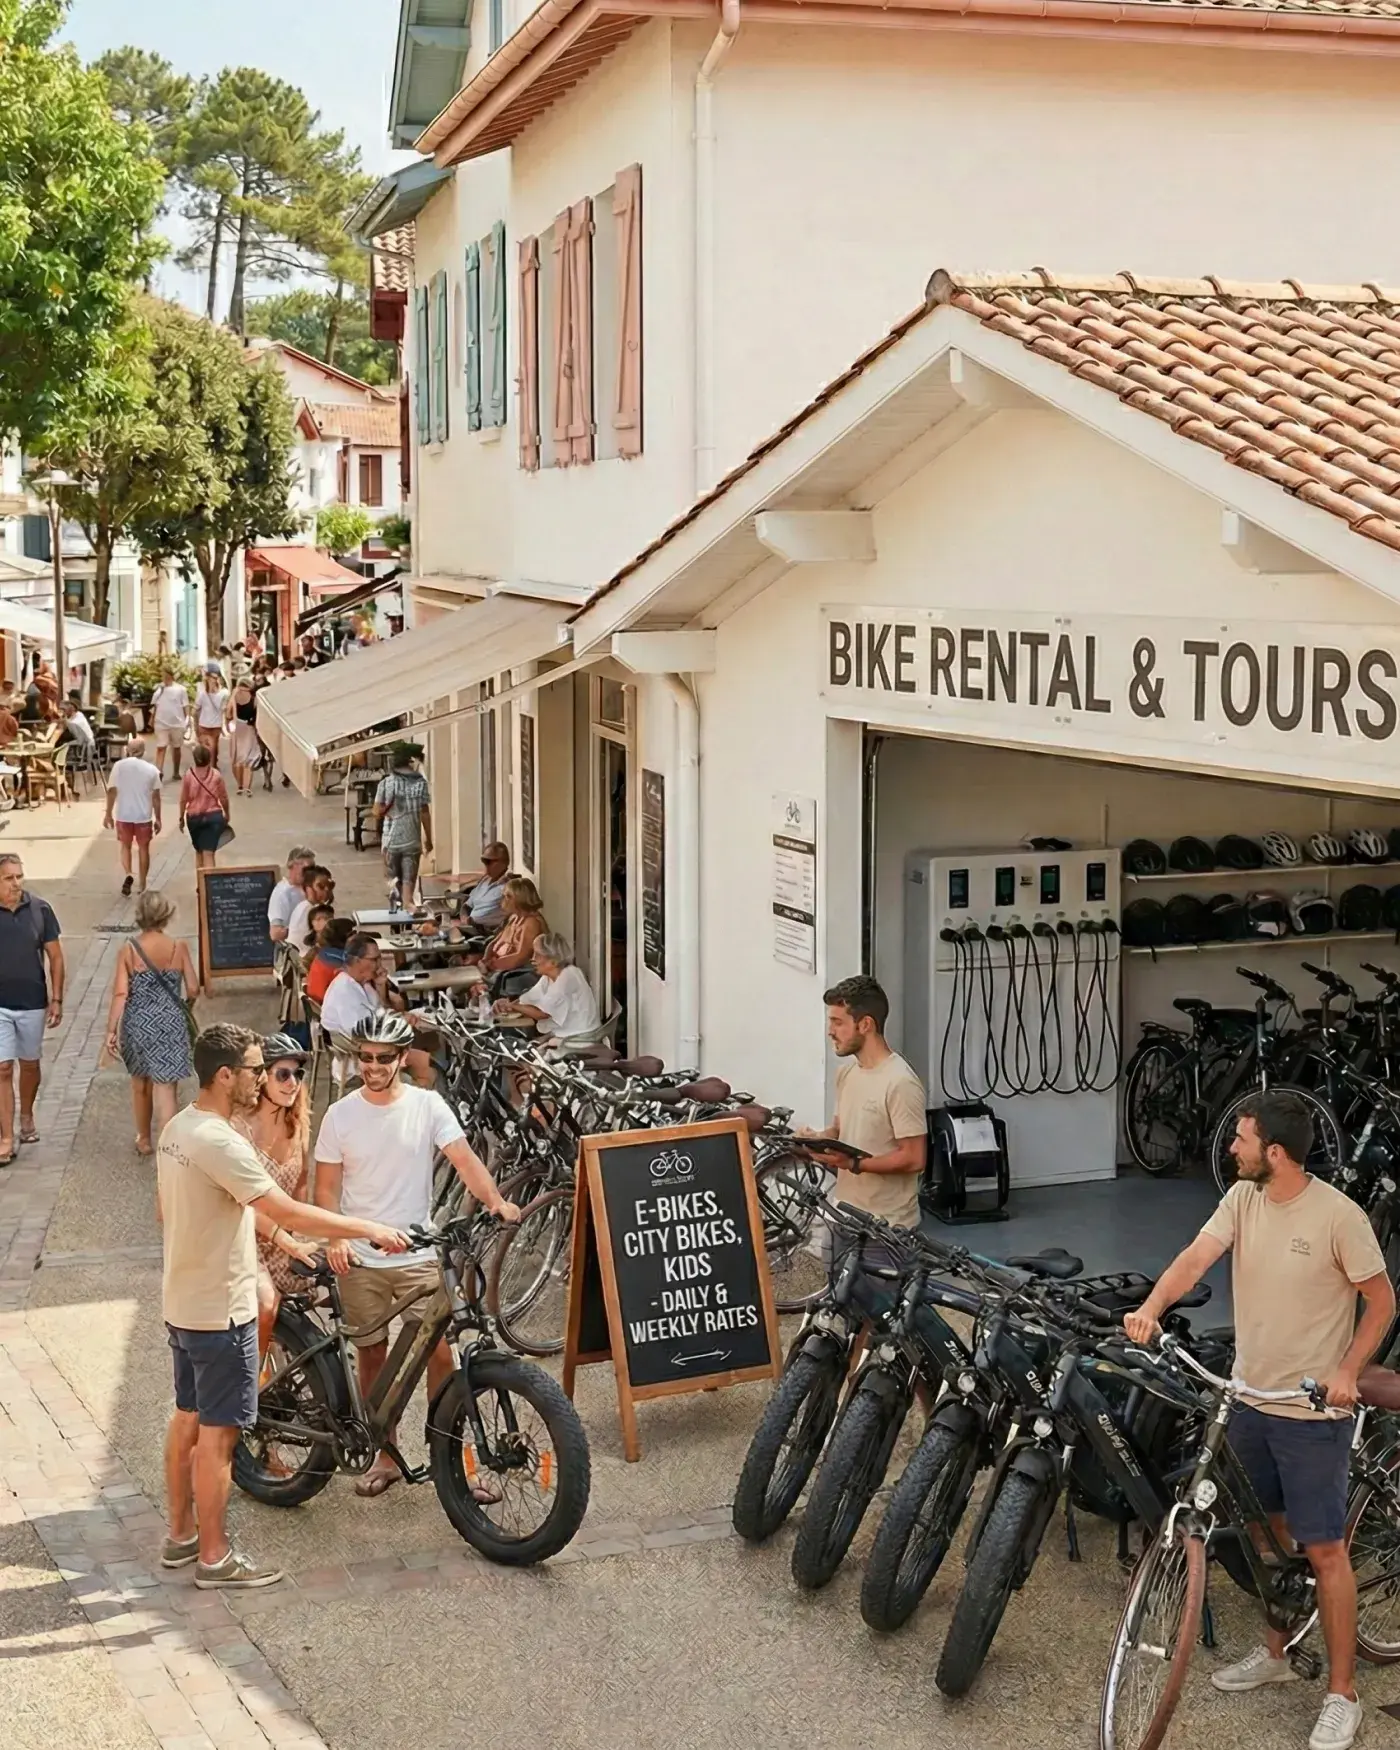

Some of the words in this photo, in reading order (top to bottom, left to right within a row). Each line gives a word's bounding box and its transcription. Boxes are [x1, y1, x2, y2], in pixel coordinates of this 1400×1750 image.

[829, 620, 916, 692] BIKE
[929, 625, 1112, 714] RENTAL
[1128, 636, 1166, 719] &
[1183, 639, 1399, 741] TOURS
[634, 1190, 724, 1226] E-BIKES,
[624, 1228, 670, 1258] CITY
[676, 1218, 742, 1252] BIKES,
[663, 1252, 713, 1283] KIDS
[661, 1285, 709, 1313] DAILY
[715, 1283, 728, 1304] &
[629, 1312, 700, 1345] WEEKLY
[705, 1305, 759, 1335] RATES
